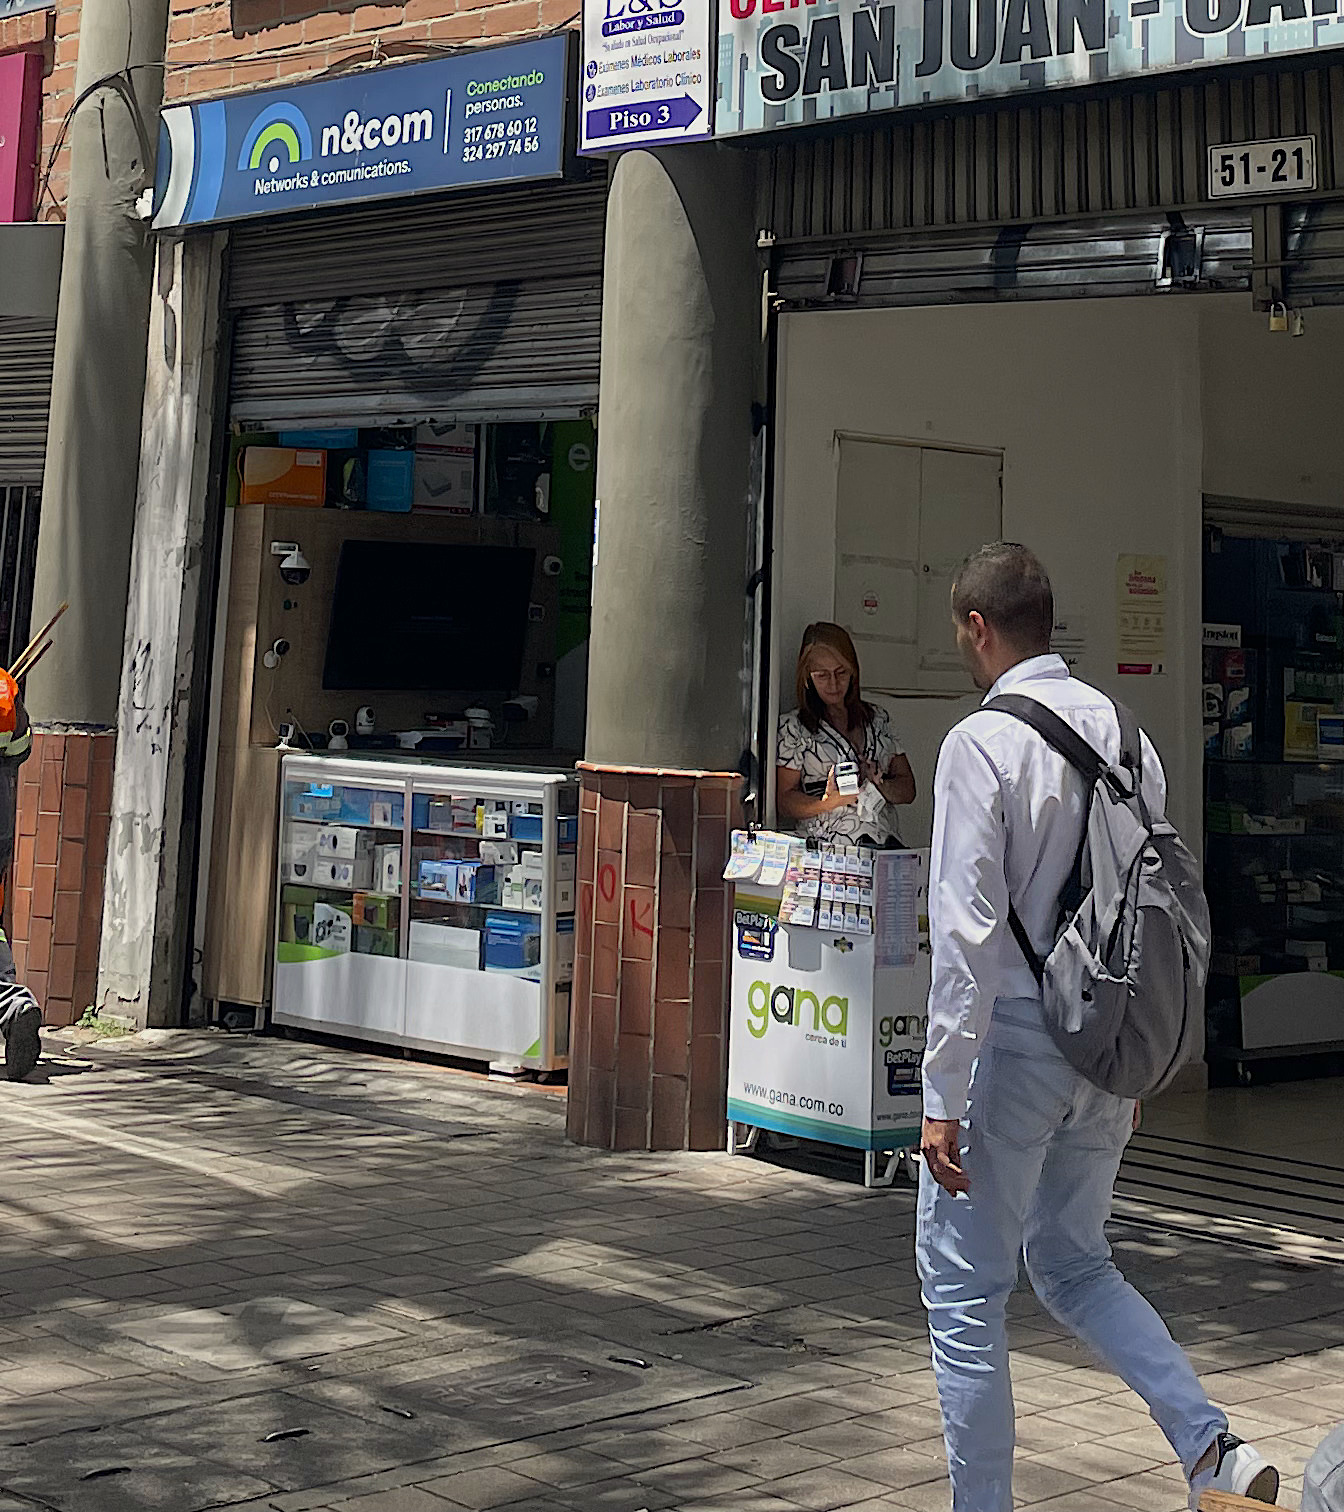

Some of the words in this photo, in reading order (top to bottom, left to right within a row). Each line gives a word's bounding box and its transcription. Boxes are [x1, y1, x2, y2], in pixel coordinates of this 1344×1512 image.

[608, 19, 635, 33] Labor
[635, 20, 643, 31] y
[646, 12, 676, 26] Salud
[631, 51, 662, 69] Médicos
[663, 47, 701, 64] Laborales
[761, 4, 896, 104] SAN
[466, 69, 544, 98] Conectando
[631, 75, 674, 93] Laboratorio
[675, 70, 702, 86] Clínico
[465, 93, 524, 120] personas.
[609, 108, 652, 131] Piso
[657, 105, 670, 124] 3
[320, 108, 433, 158] n&com
[463, 127, 482, 145] 317
[483, 123, 505, 142] 678
[507, 121, 522, 138] 60
[524, 117, 537, 135] 12
[462, 144, 483, 163] 324
[484, 141, 507, 160] 297
[508, 139, 523, 156] 74
[523, 136, 539, 154] 56
[1220, 146, 1304, 187] 51-21
[254, 172, 309, 196] Networks
[310, 170, 319, 187] &
[747, 980, 848, 1039] gana
[805, 1033, 827, 1046] cerca
[829, 1036, 839, 1047] de
[841, 1038, 847, 1048] ti
[743, 1080, 844, 1117] www.gana.com.co
